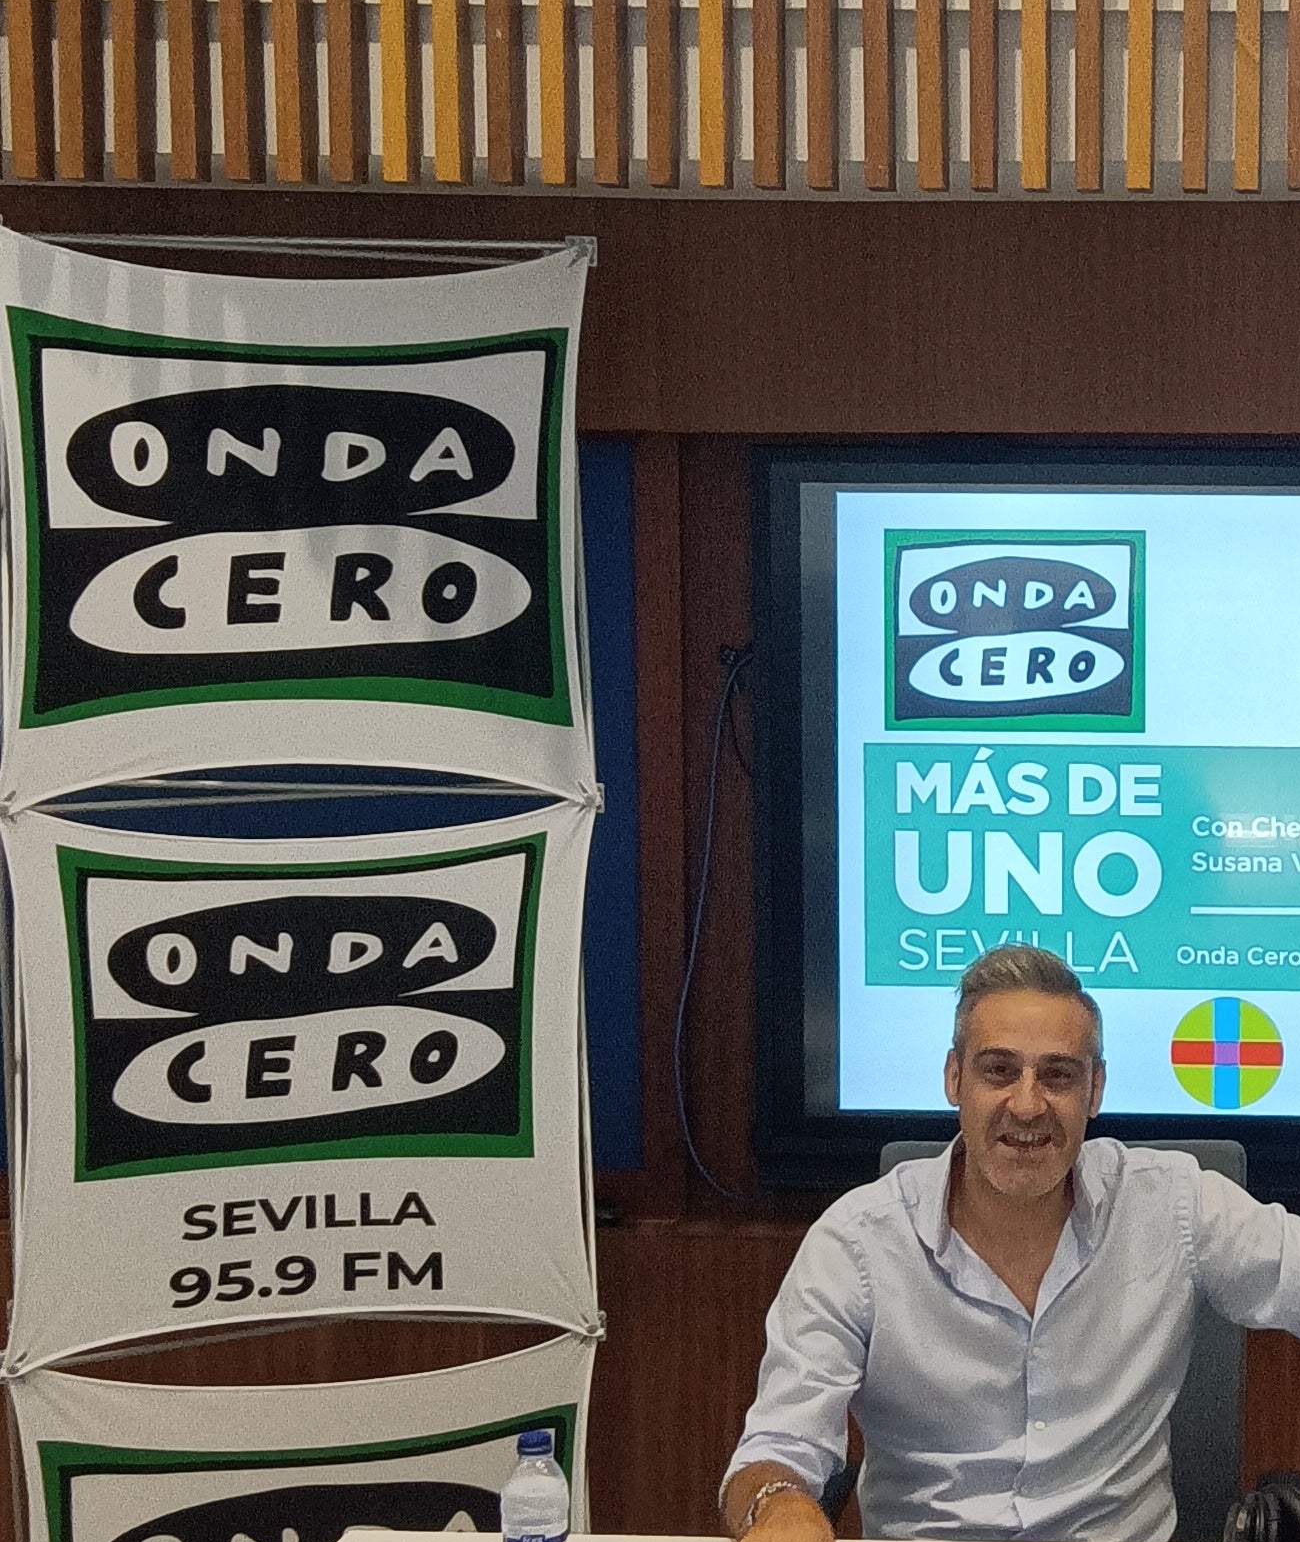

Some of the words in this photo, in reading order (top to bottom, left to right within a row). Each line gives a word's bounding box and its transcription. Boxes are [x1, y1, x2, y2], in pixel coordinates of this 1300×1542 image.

[110, 421, 473, 486] ONDA
[133, 551, 477, 629] CERO
[930, 578, 1096, 613] ONDA
[939, 647, 1096, 685] CERO
[896, 747, 1050, 816] MÁS
[1068, 763, 1163, 816] DE
[1192, 816, 1243, 838] Con
[894, 830, 1163, 918] UNO
[1192, 851, 1283, 873] Susana
[146, 922, 458, 986] ONDA
[1176, 946, 1240, 965] Onda
[166, 1029, 459, 1103] CERO
[181, 1192, 437, 1241] SEVILLA
[168, 1255, 318, 1309] 95.9
[342, 1251, 444, 1291] FM
